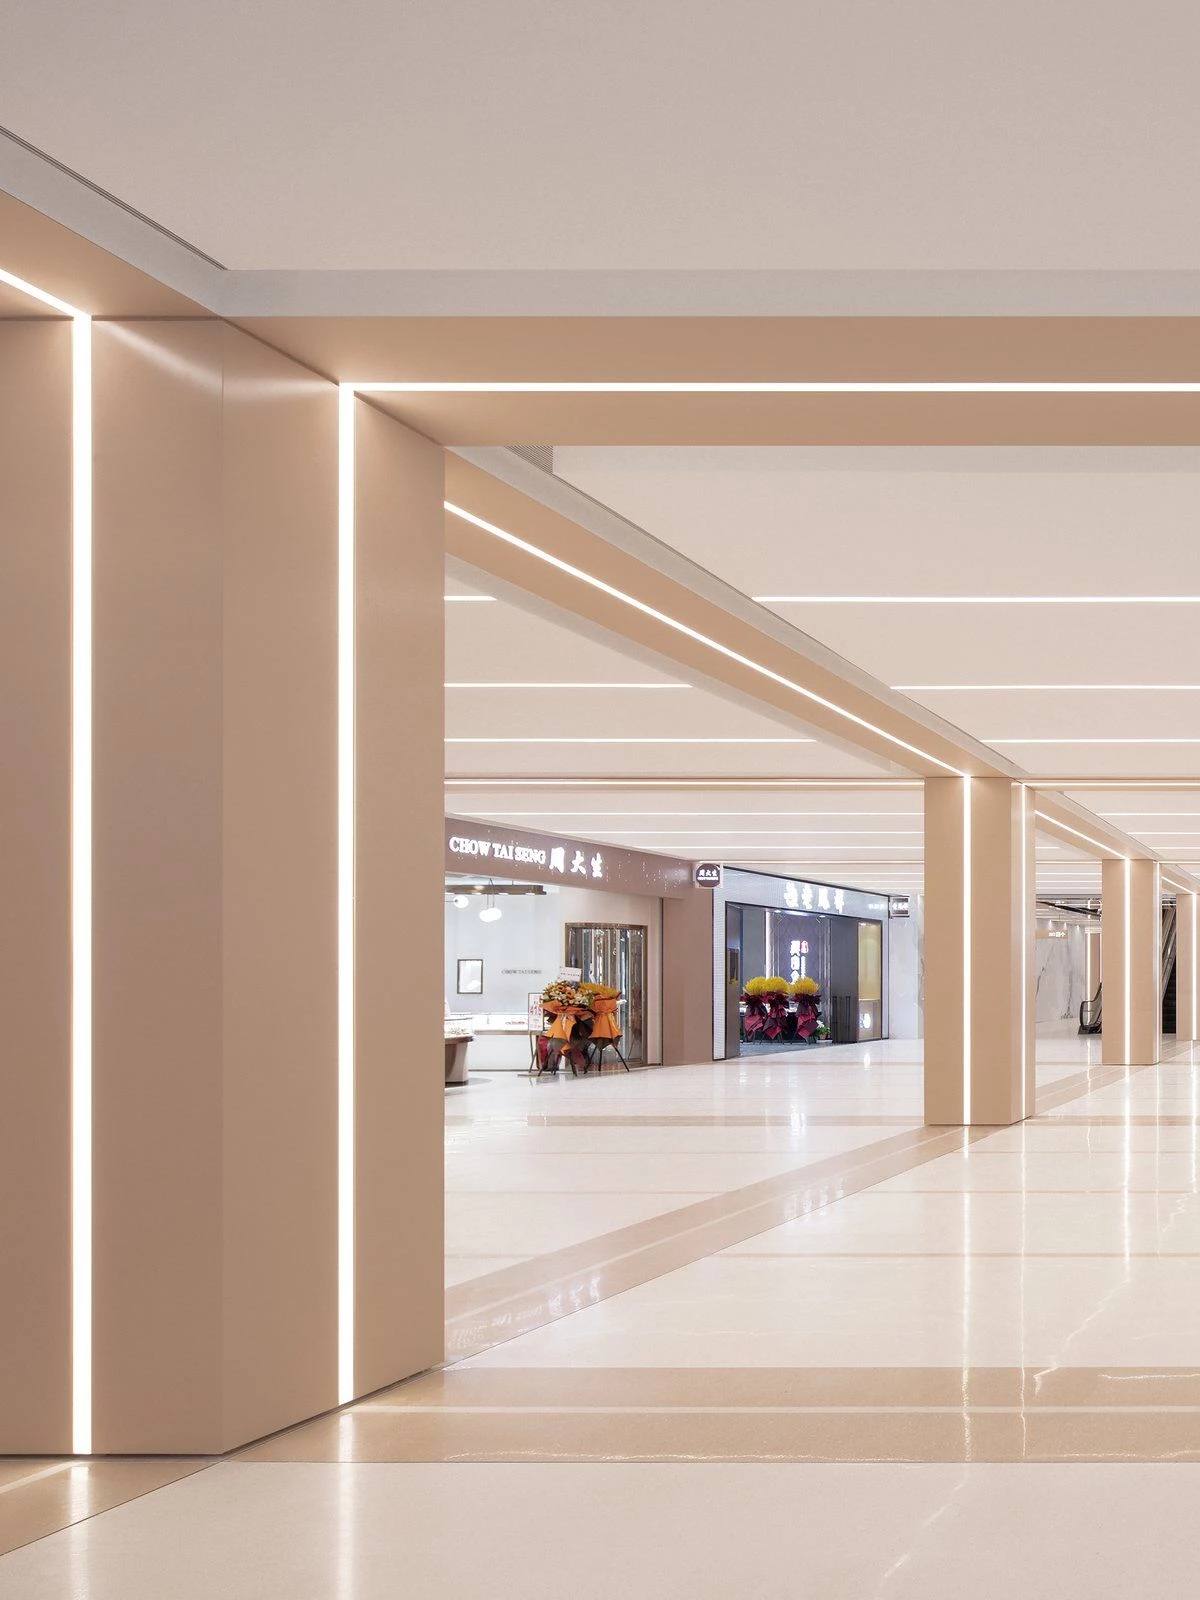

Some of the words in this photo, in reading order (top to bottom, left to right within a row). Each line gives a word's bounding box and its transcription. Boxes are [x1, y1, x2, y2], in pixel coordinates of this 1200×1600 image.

[449, 836, 491, 857] CHOW
[492, 842, 514, 860] TAI
[514, 846, 547, 865] SENG
[549, 846, 603, 878] 周大生
